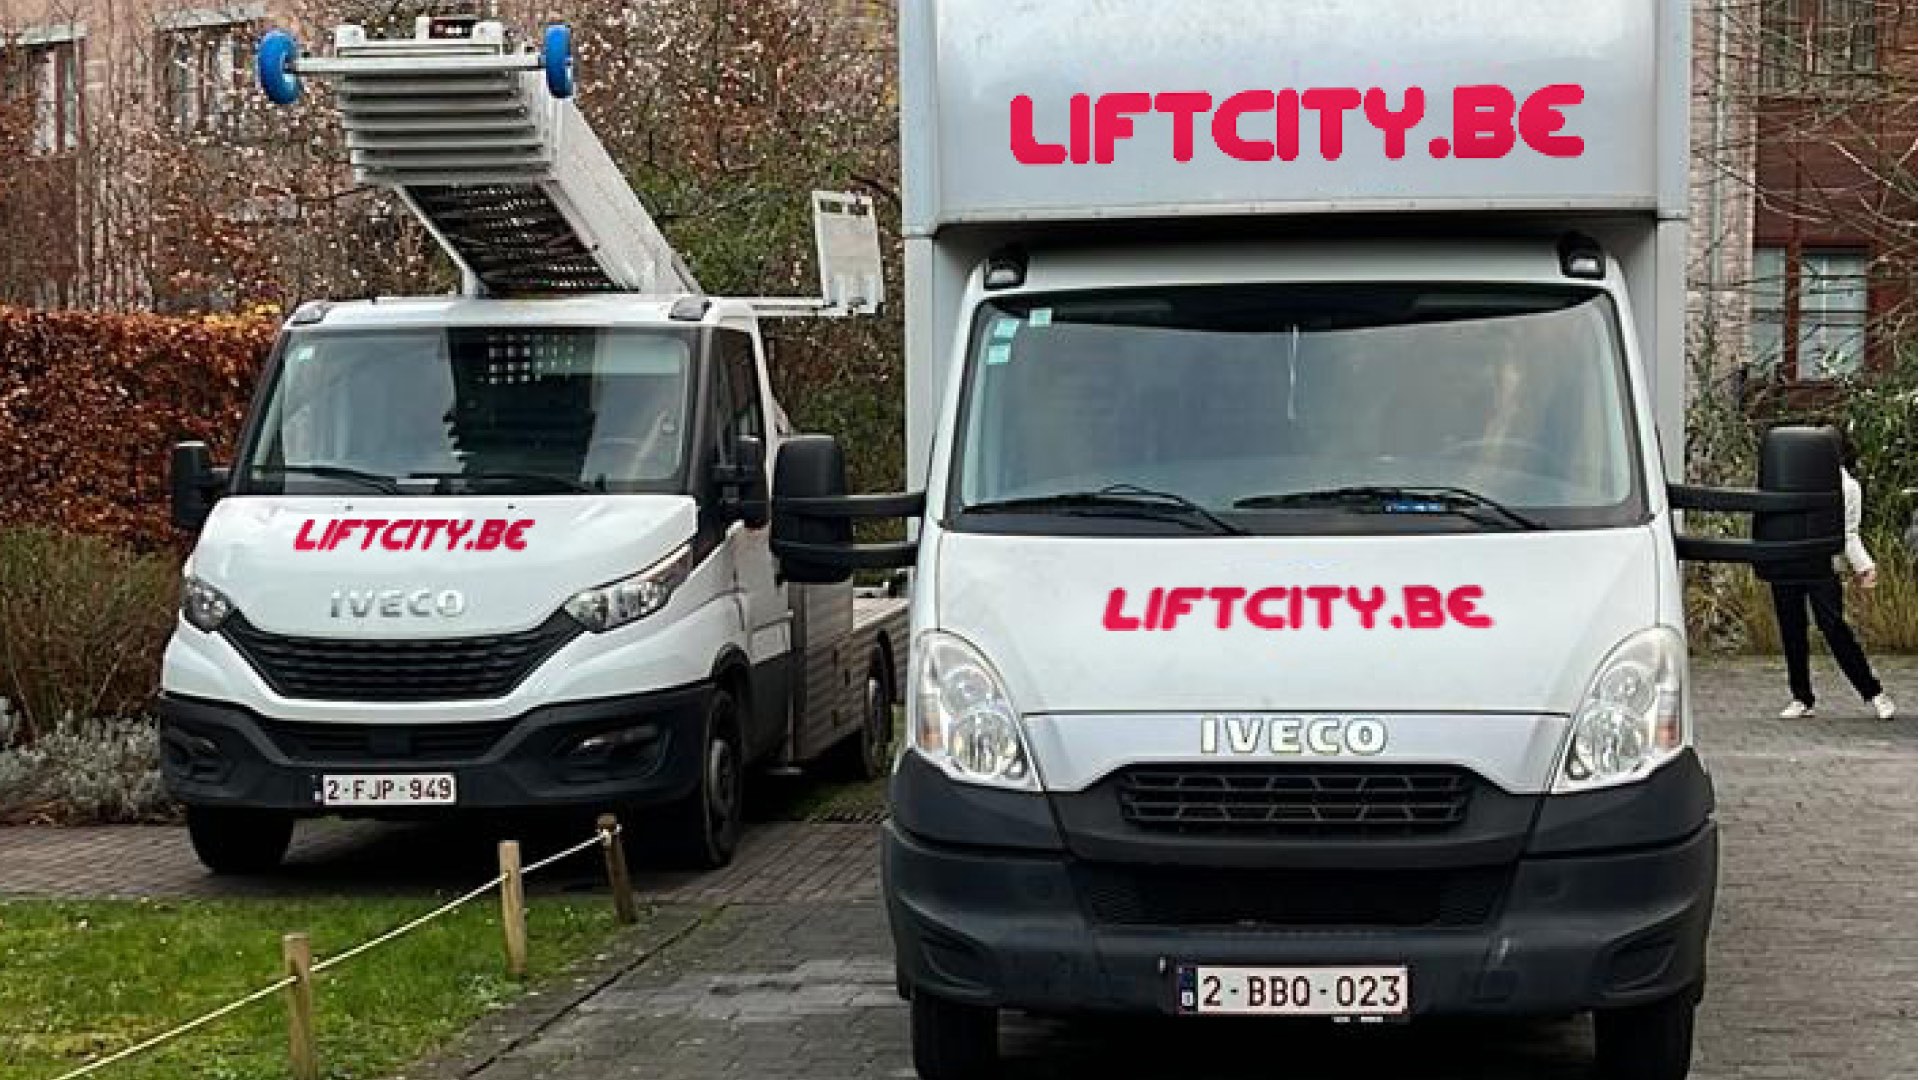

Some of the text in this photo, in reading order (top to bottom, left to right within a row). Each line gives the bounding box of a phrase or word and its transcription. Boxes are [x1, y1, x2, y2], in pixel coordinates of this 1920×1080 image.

[1010, 83, 1584, 165] LIFTCITY.BE
[293, 519, 536, 551] LIFTCITY.BE
[331, 588, 464, 618] IVECO
[1102, 585, 1495, 631] LIFTCITY.BE
[1200, 717, 1389, 753] IVECO
